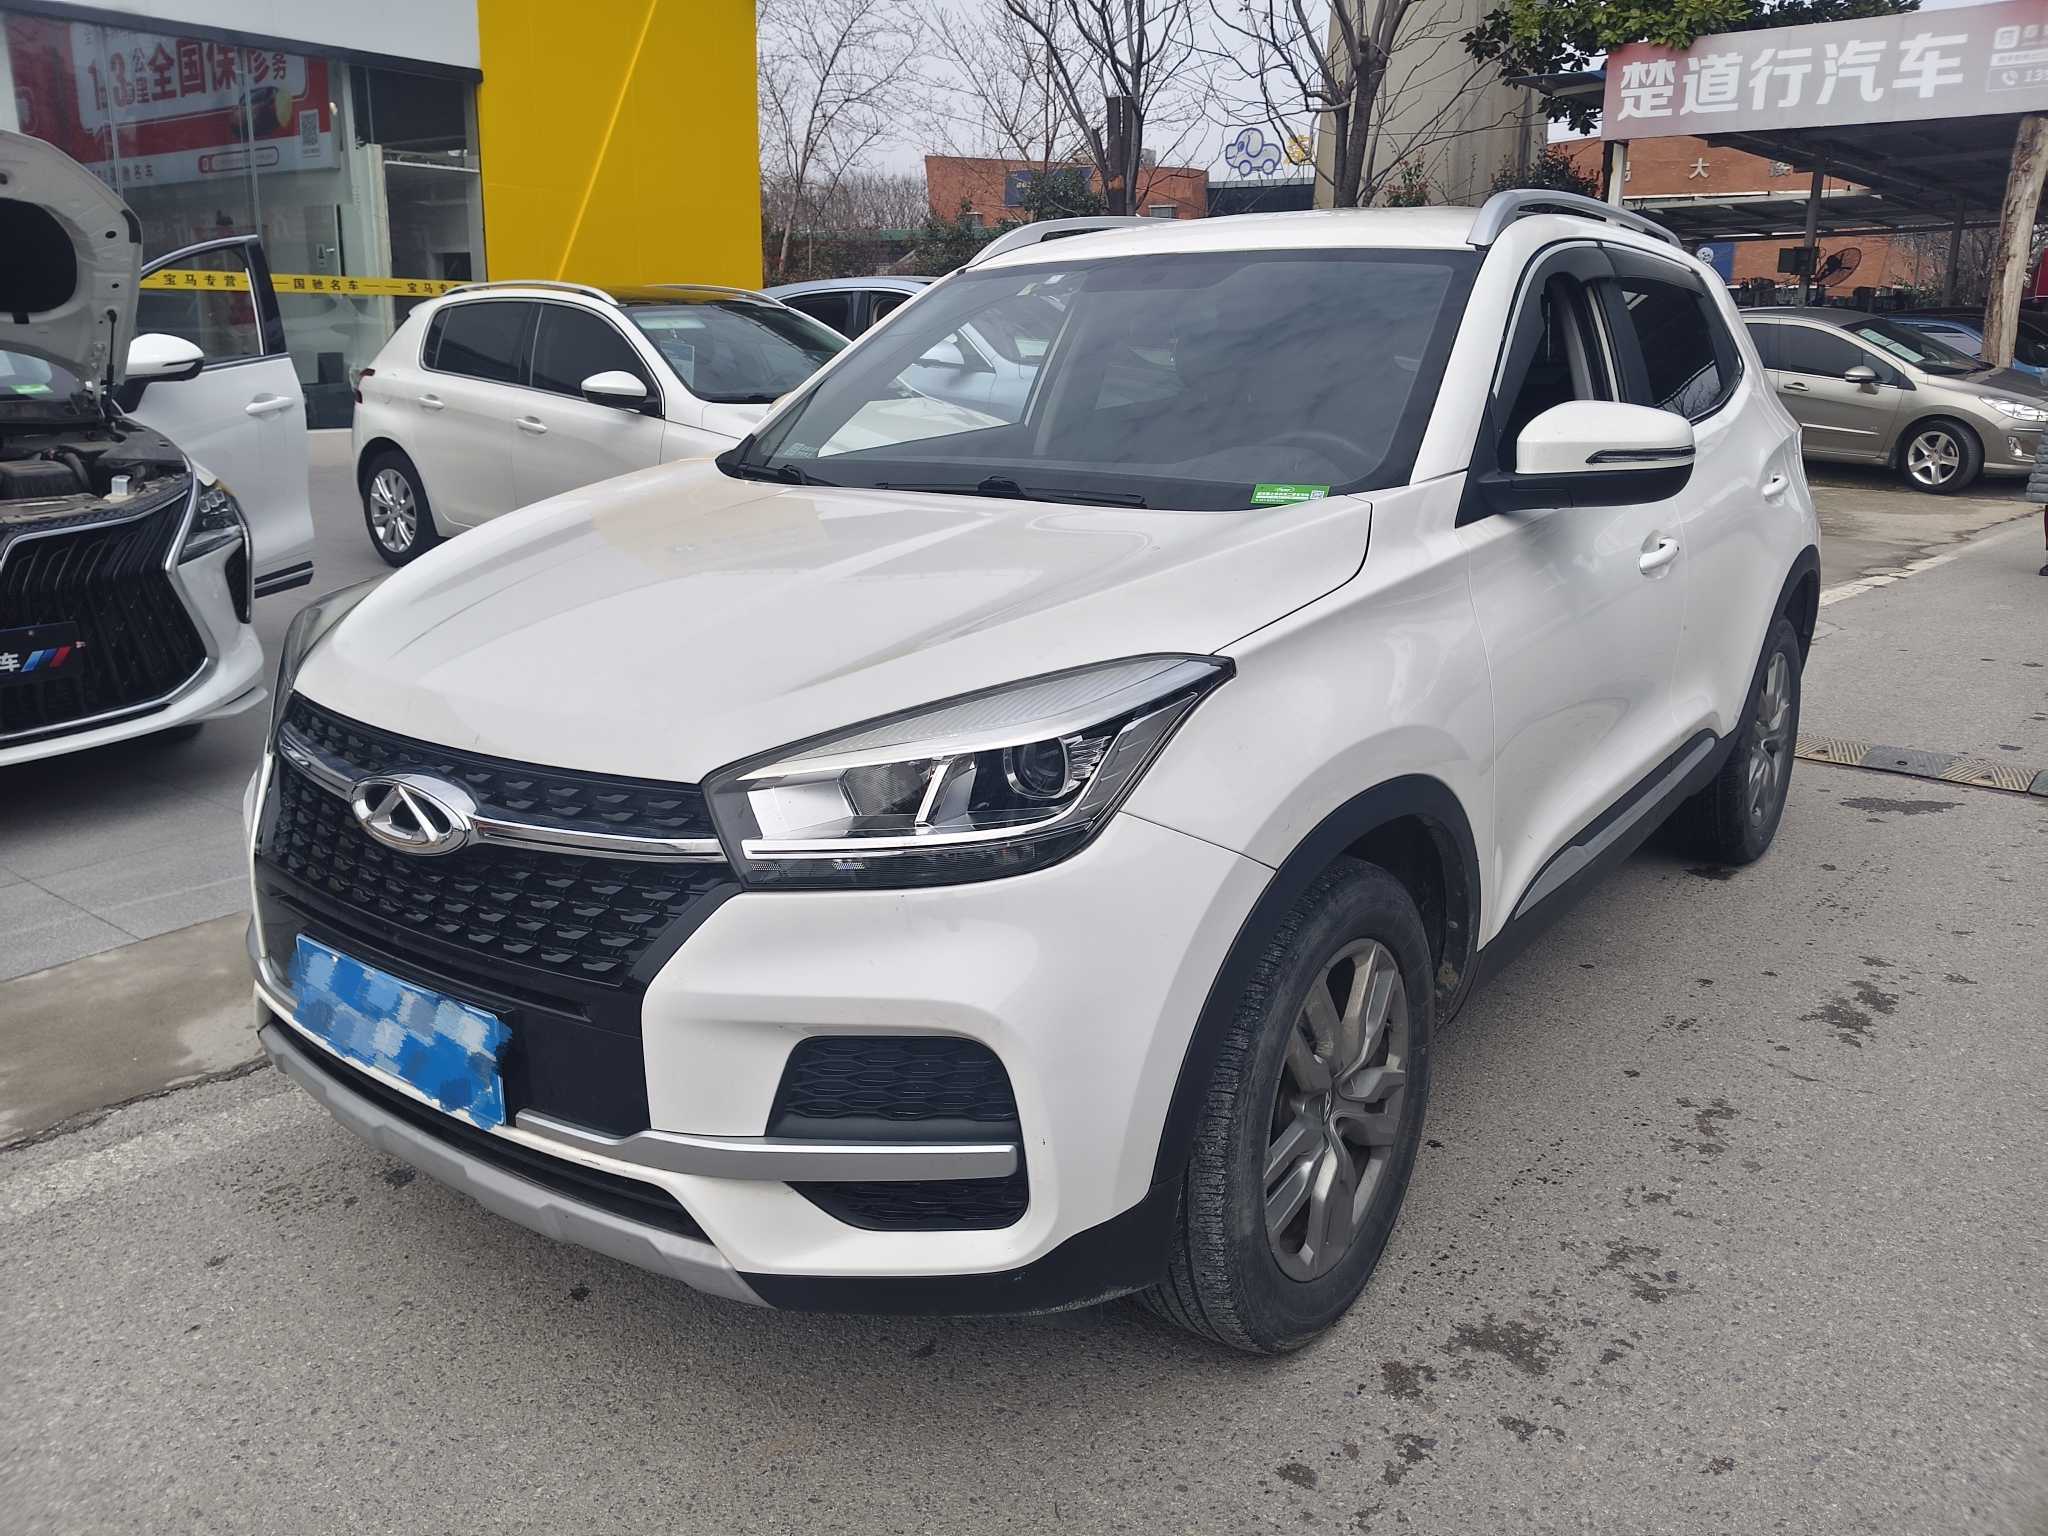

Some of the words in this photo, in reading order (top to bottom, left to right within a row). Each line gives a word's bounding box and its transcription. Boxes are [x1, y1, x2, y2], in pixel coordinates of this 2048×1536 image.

[1617, 32, 1969, 121] 楚道行汽车
[163, 273, 236, 287] 宝马专营
[293, 278, 360, 291] 国驰名车
[407, 282, 462, 294] 宝马专
